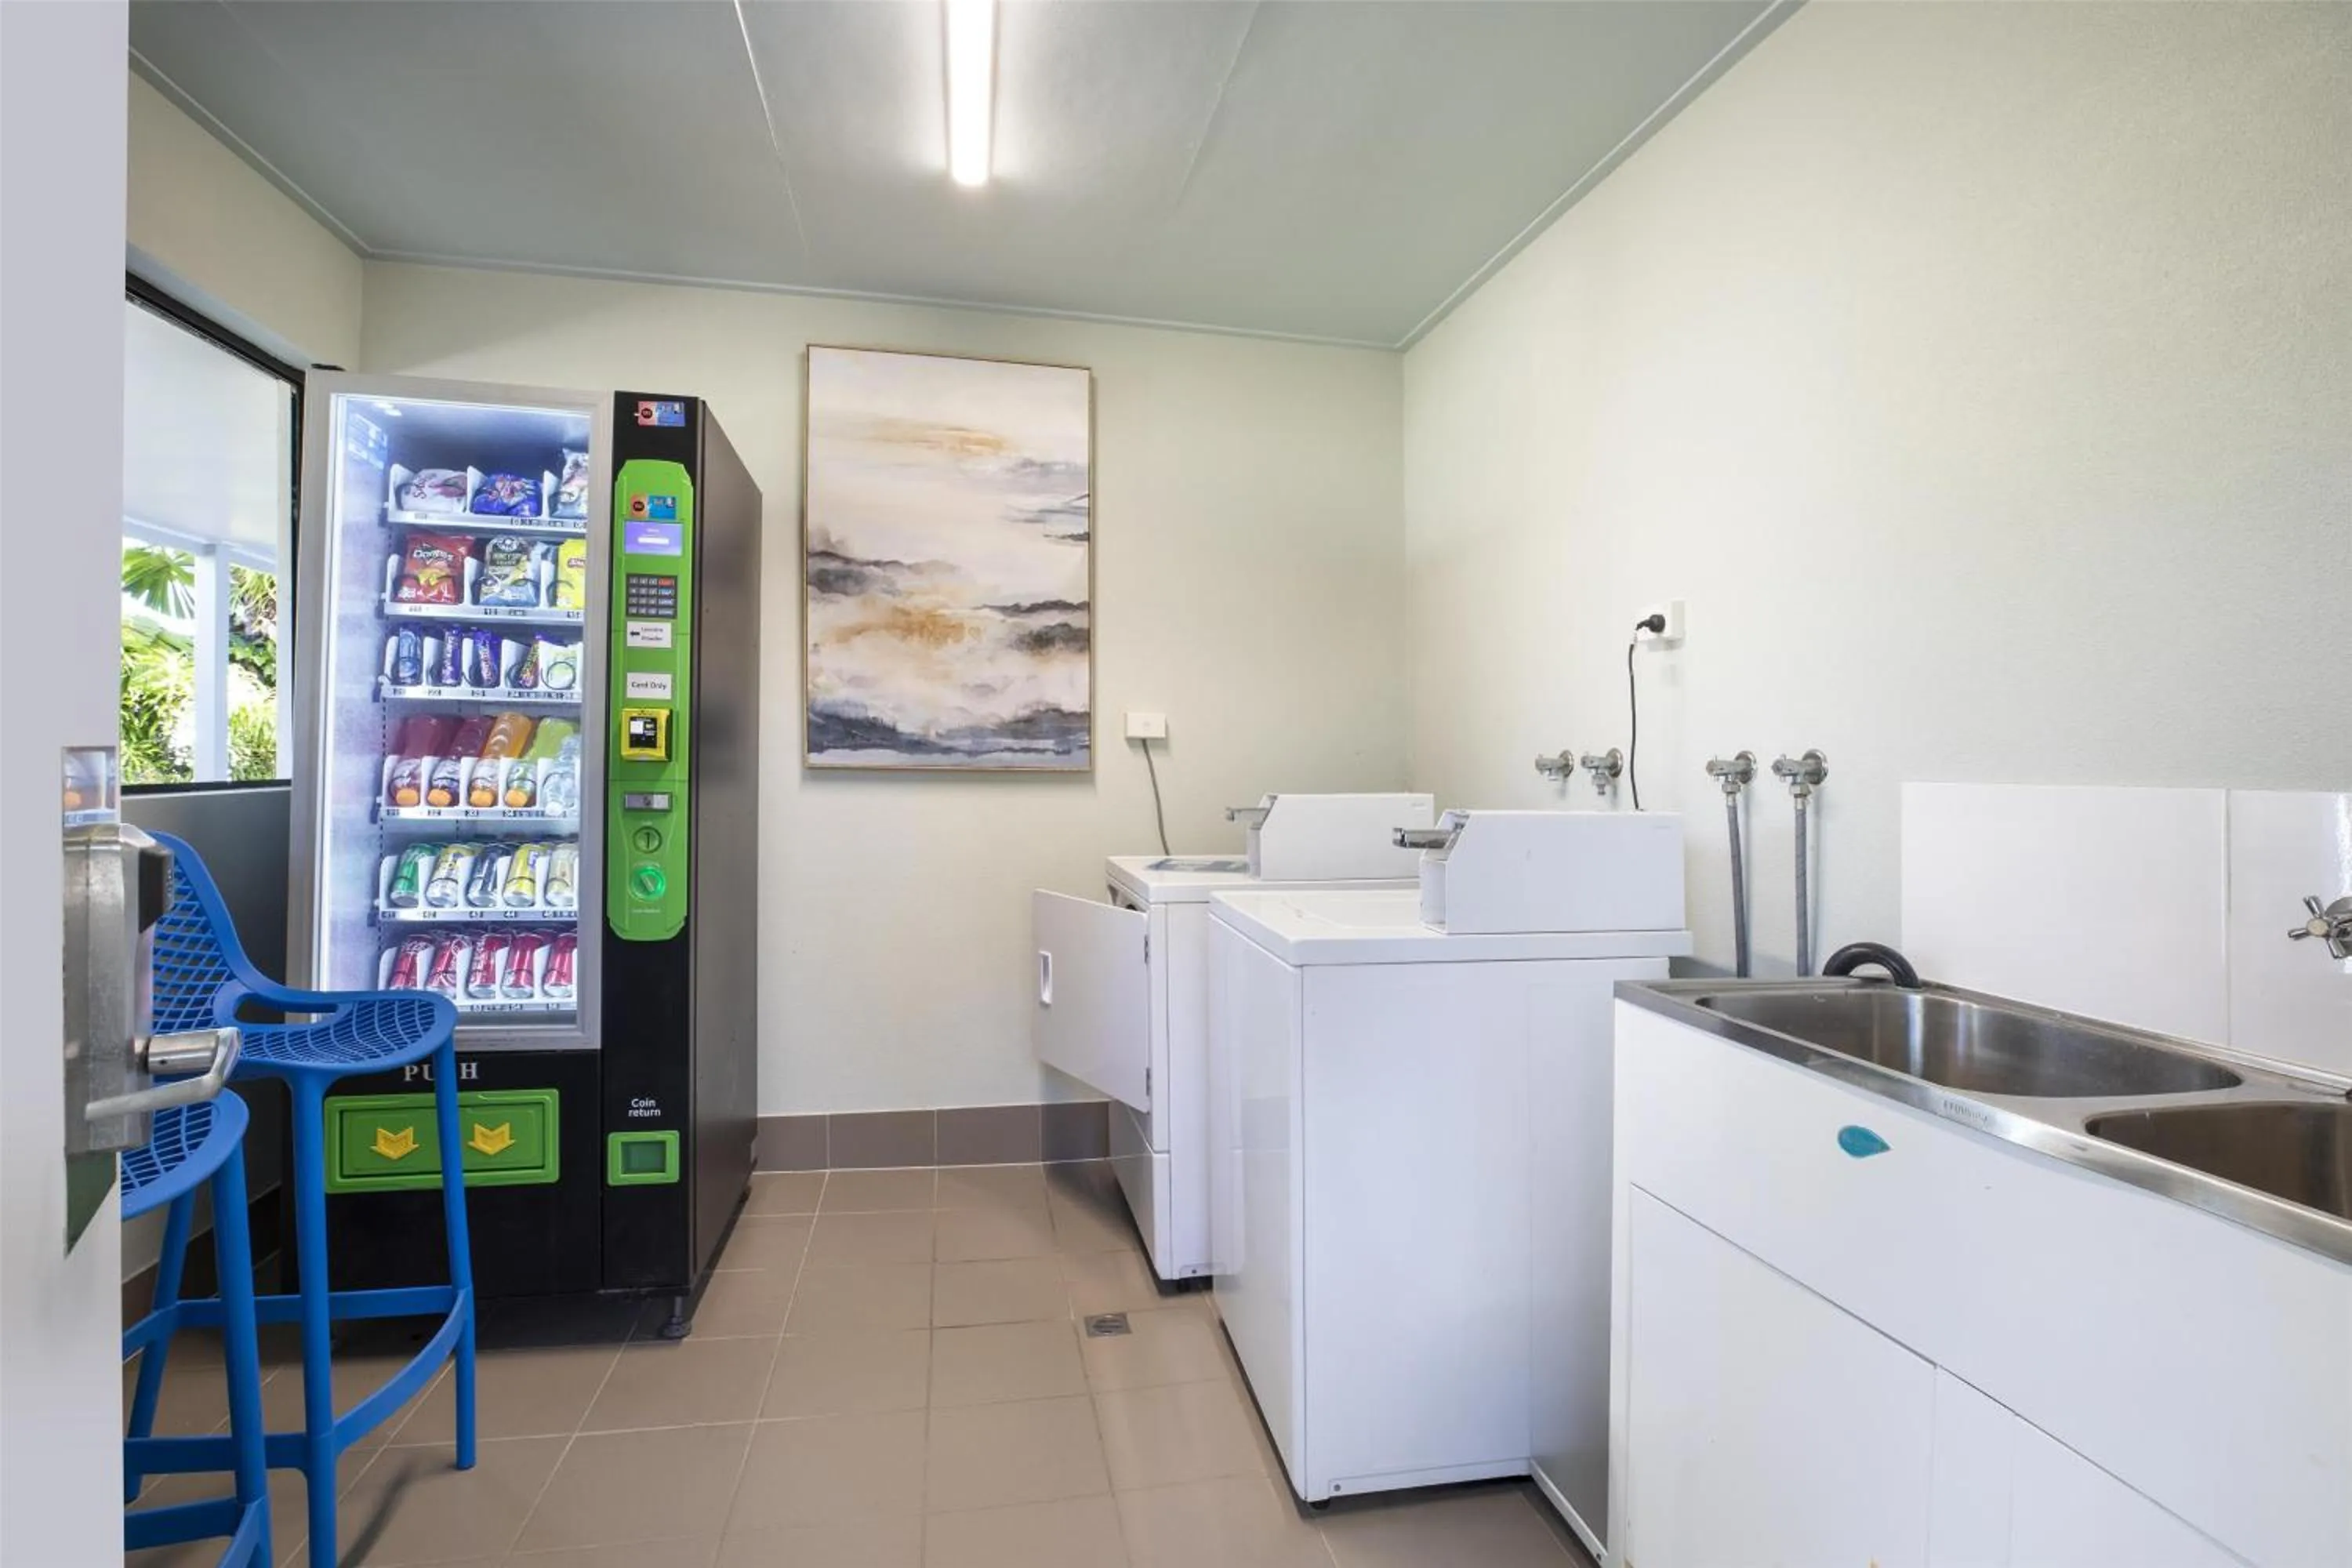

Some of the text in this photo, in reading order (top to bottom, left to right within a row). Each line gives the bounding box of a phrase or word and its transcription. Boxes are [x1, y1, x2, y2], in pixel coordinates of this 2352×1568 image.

[650, 681, 667, 691] Only
[404, 1062, 478, 1081] PUH
[631, 1097, 656, 1108] Coin
[628, 1107, 661, 1117] return
